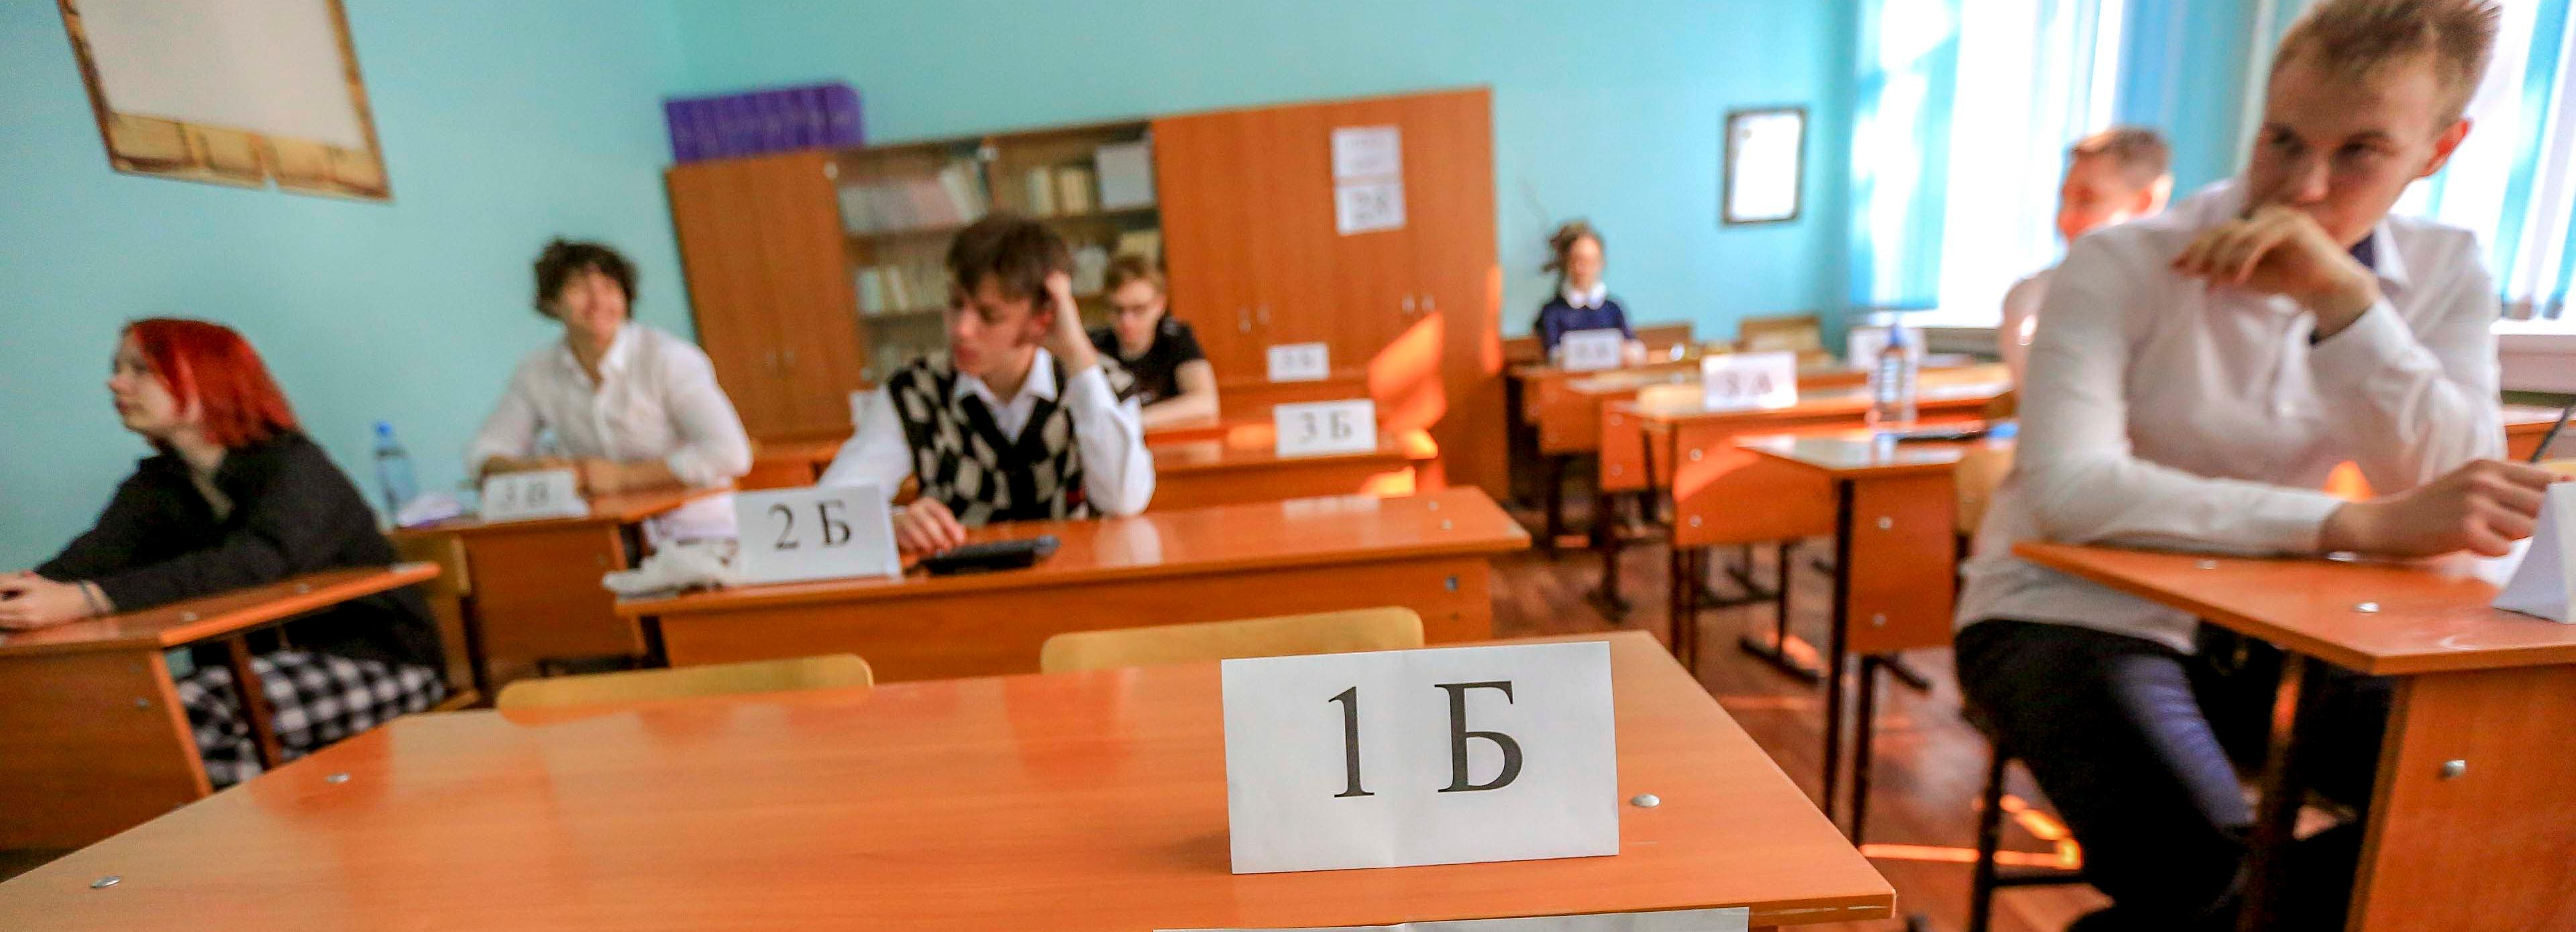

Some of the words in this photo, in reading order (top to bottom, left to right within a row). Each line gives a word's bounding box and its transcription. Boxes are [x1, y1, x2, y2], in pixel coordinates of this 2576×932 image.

[769, 503, 799, 550] 2
[816, 500, 852, 546] Б
[1328, 686, 1375, 798] 1
[1434, 680, 1523, 793] Б
